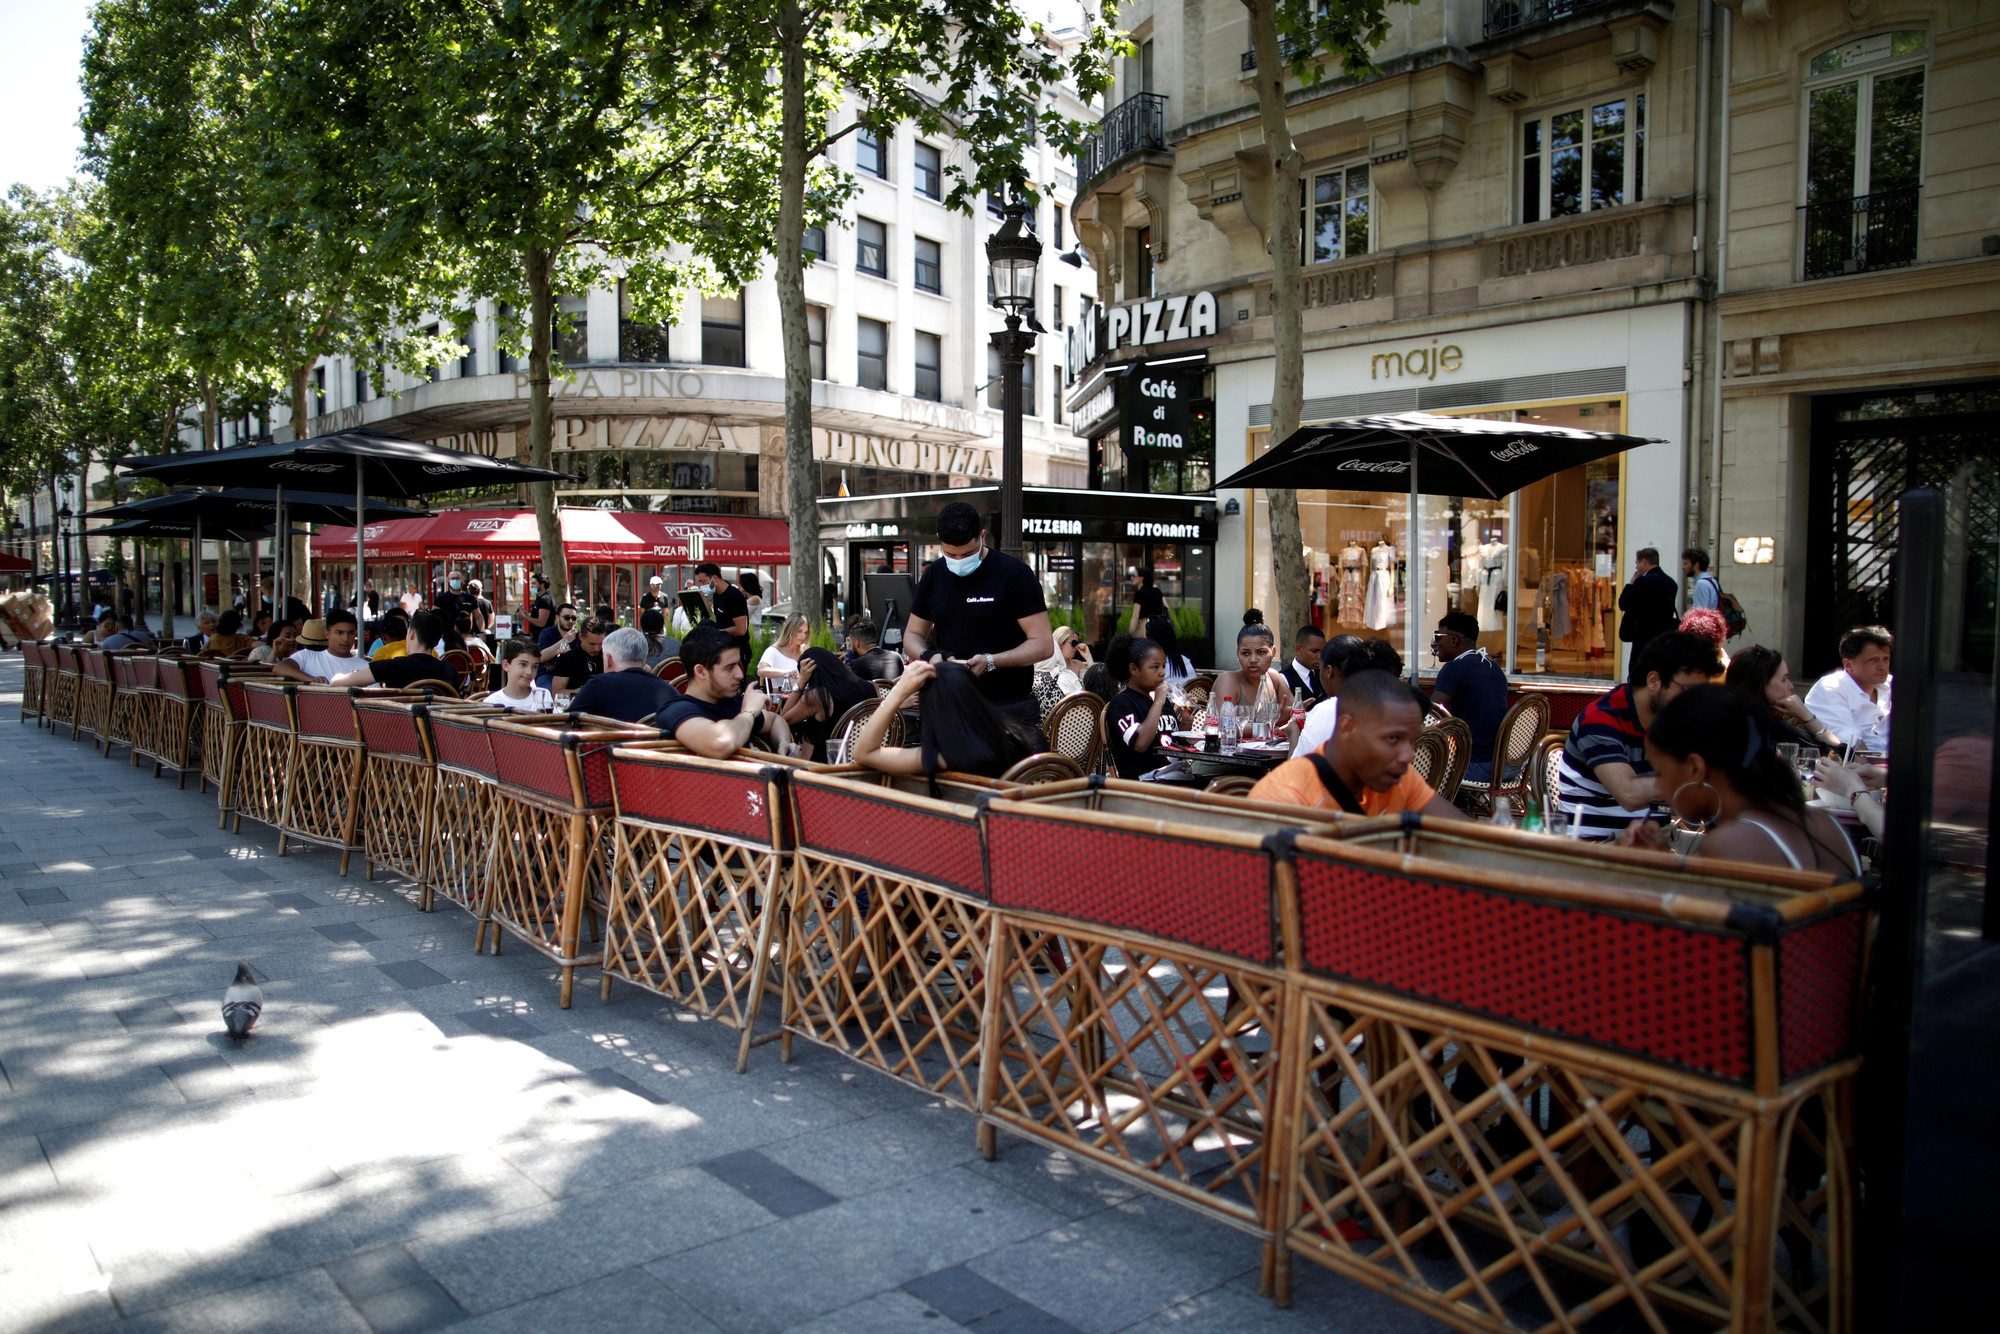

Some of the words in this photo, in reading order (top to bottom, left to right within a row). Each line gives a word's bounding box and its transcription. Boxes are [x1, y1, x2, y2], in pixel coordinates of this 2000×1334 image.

[1108, 290, 1217, 350] PIZZA
[1372, 339, 1463, 381] maje
[620, 371, 704, 398] PINO
[1140, 378, 1176, 399] Café
[342, 404, 364, 429] PINO
[901, 397, 940, 429] PIZZA
[1074, 384, 1112, 433] PIZZERIA
[1153, 406, 1165, 420] di
[555, 417, 742, 450] PIZZA
[1133, 425, 1183, 448] Roma
[825, 429, 907, 467] PINO
[915, 441, 1000, 478] PIZZA
[467, 520, 499, 530] PIZZA
[702, 527, 733, 538] PINO
[846, 523, 866, 538] Café
[871, 523, 899, 536] Roma
[1022, 519, 1082, 535] PIZZERIA
[1127, 522, 1200, 539] RISTORANTE
[654, 546, 677, 556] PIZZA
[677, 546, 689, 556] PIN
[704, 549, 762, 557] RESTAURANT
